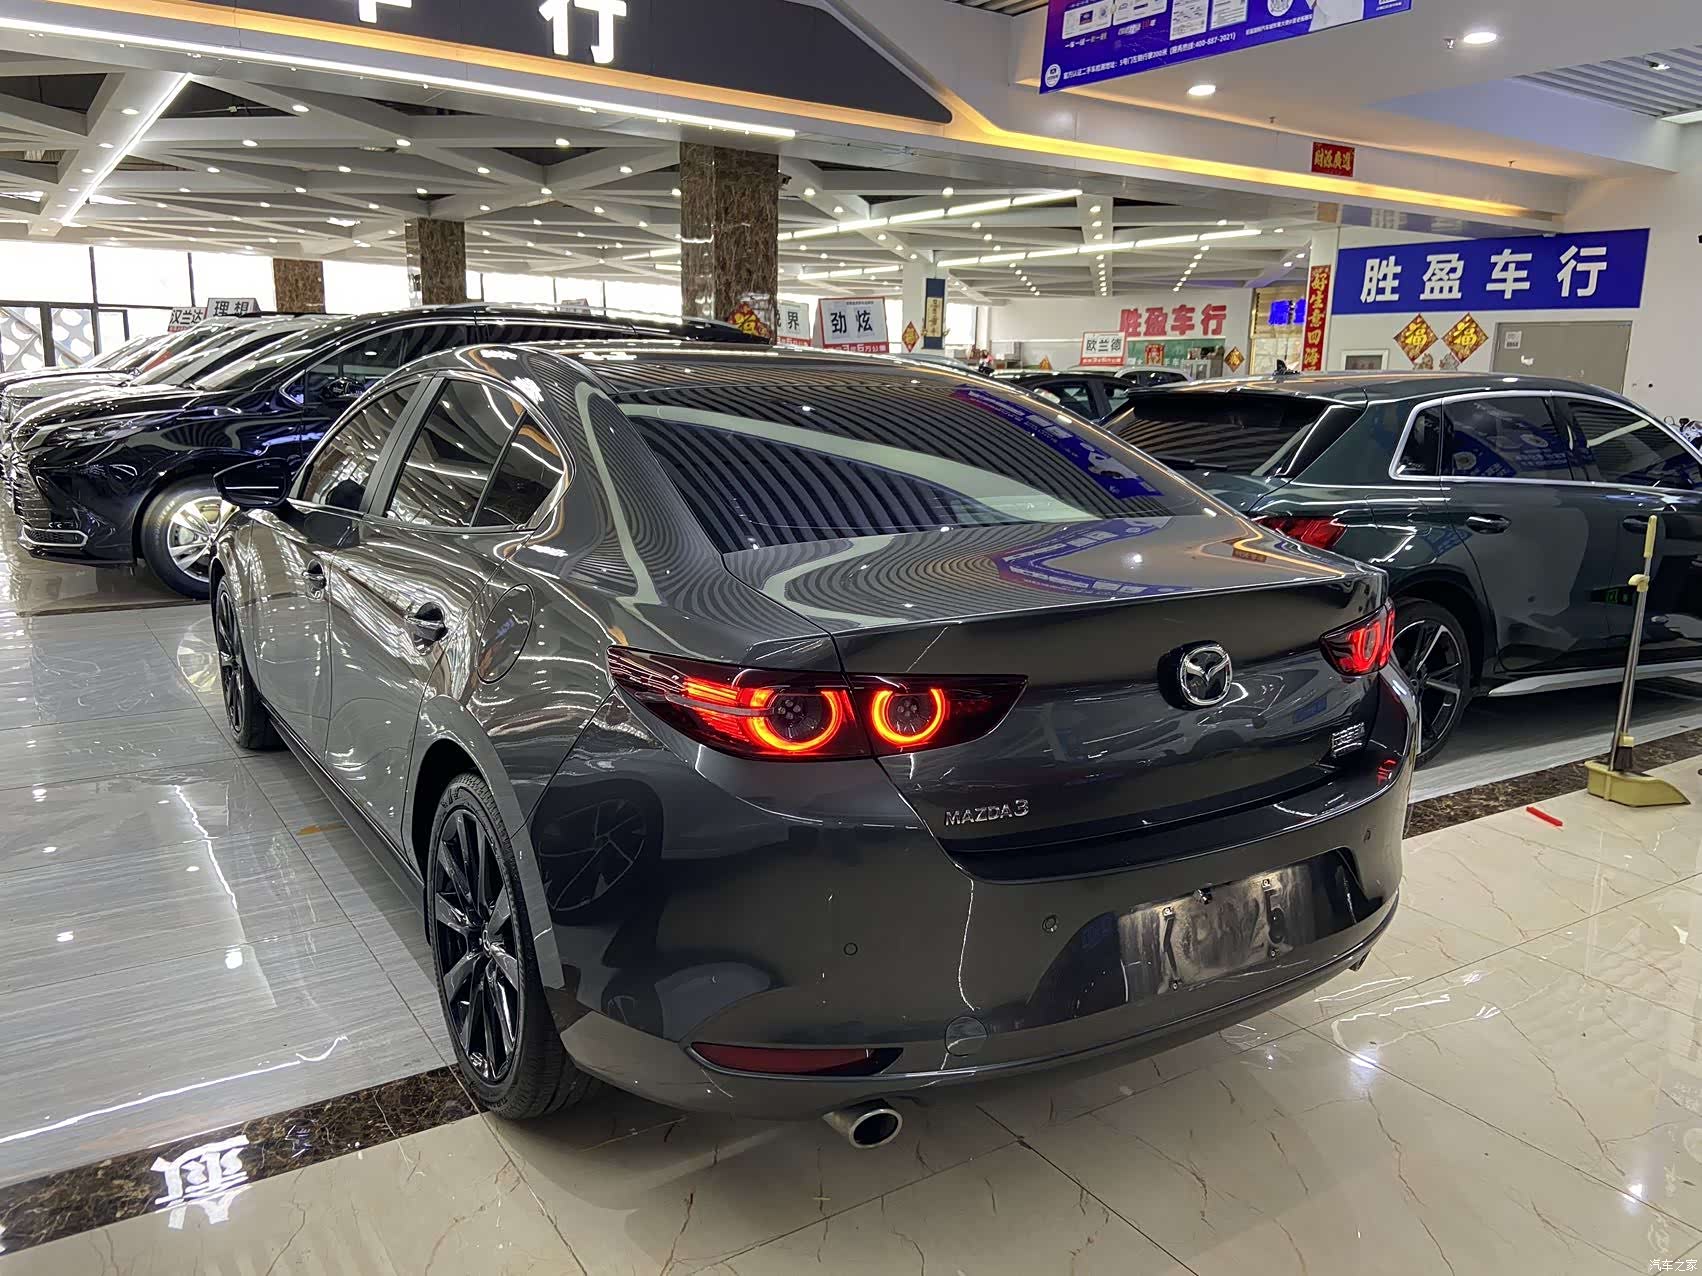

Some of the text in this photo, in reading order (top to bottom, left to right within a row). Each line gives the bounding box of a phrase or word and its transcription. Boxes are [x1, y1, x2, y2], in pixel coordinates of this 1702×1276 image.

[1360, 245, 1608, 304] 胜盈车行
[169, 308, 203, 325] 汉兰达
[830, 309, 873, 334] 劲炫
[1119, 302, 1227, 338] 胜盈车行
[1086, 338, 1122, 352] 欧兰德
[945, 798, 1030, 826] MAZDA3
